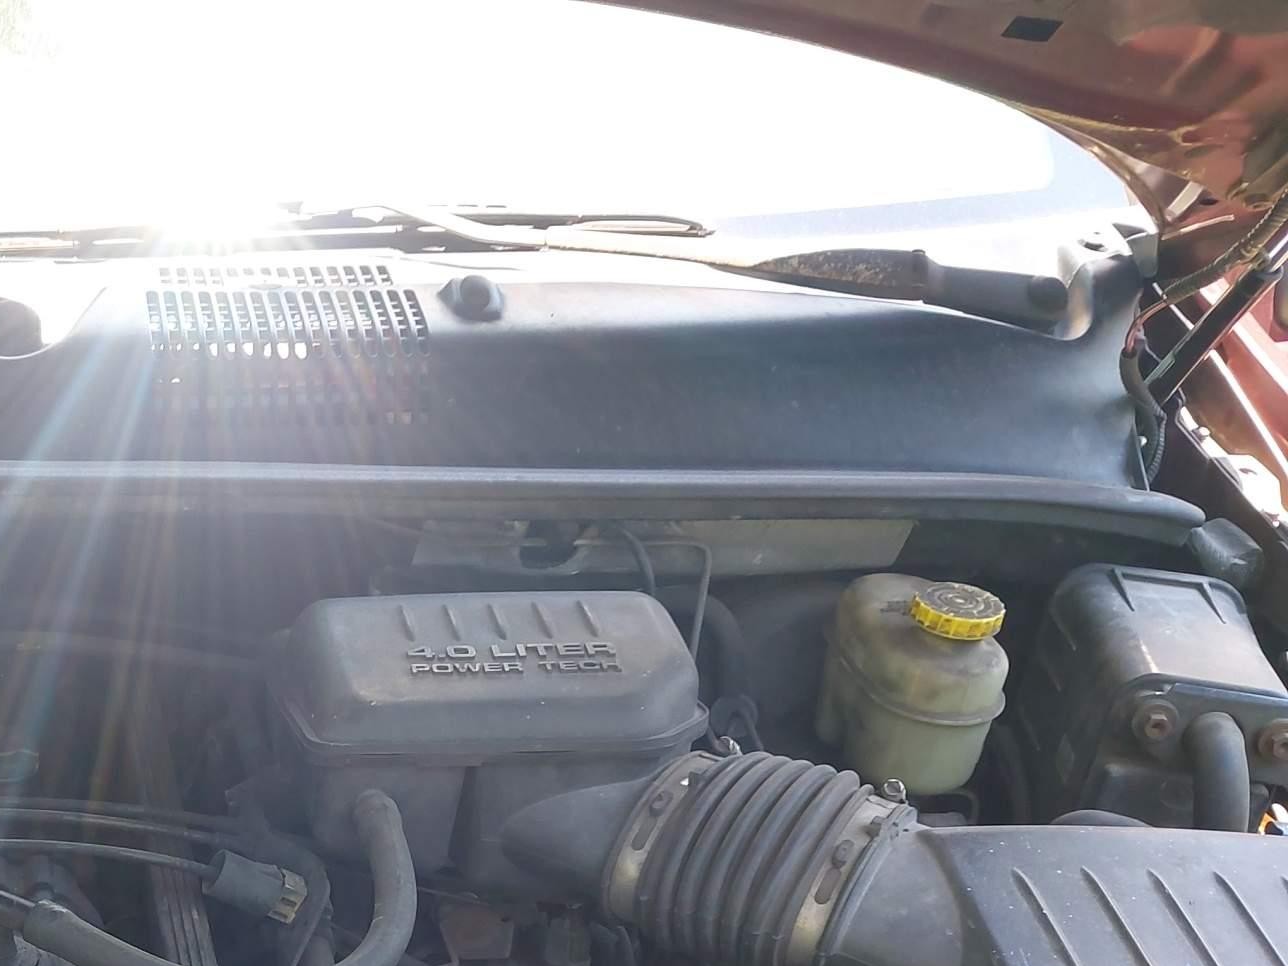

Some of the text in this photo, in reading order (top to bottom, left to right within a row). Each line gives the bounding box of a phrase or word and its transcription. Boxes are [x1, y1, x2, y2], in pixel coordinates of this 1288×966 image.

[406, 640, 617, 659] 4.0 LITER
[410, 659, 623, 673] POWER TECH
